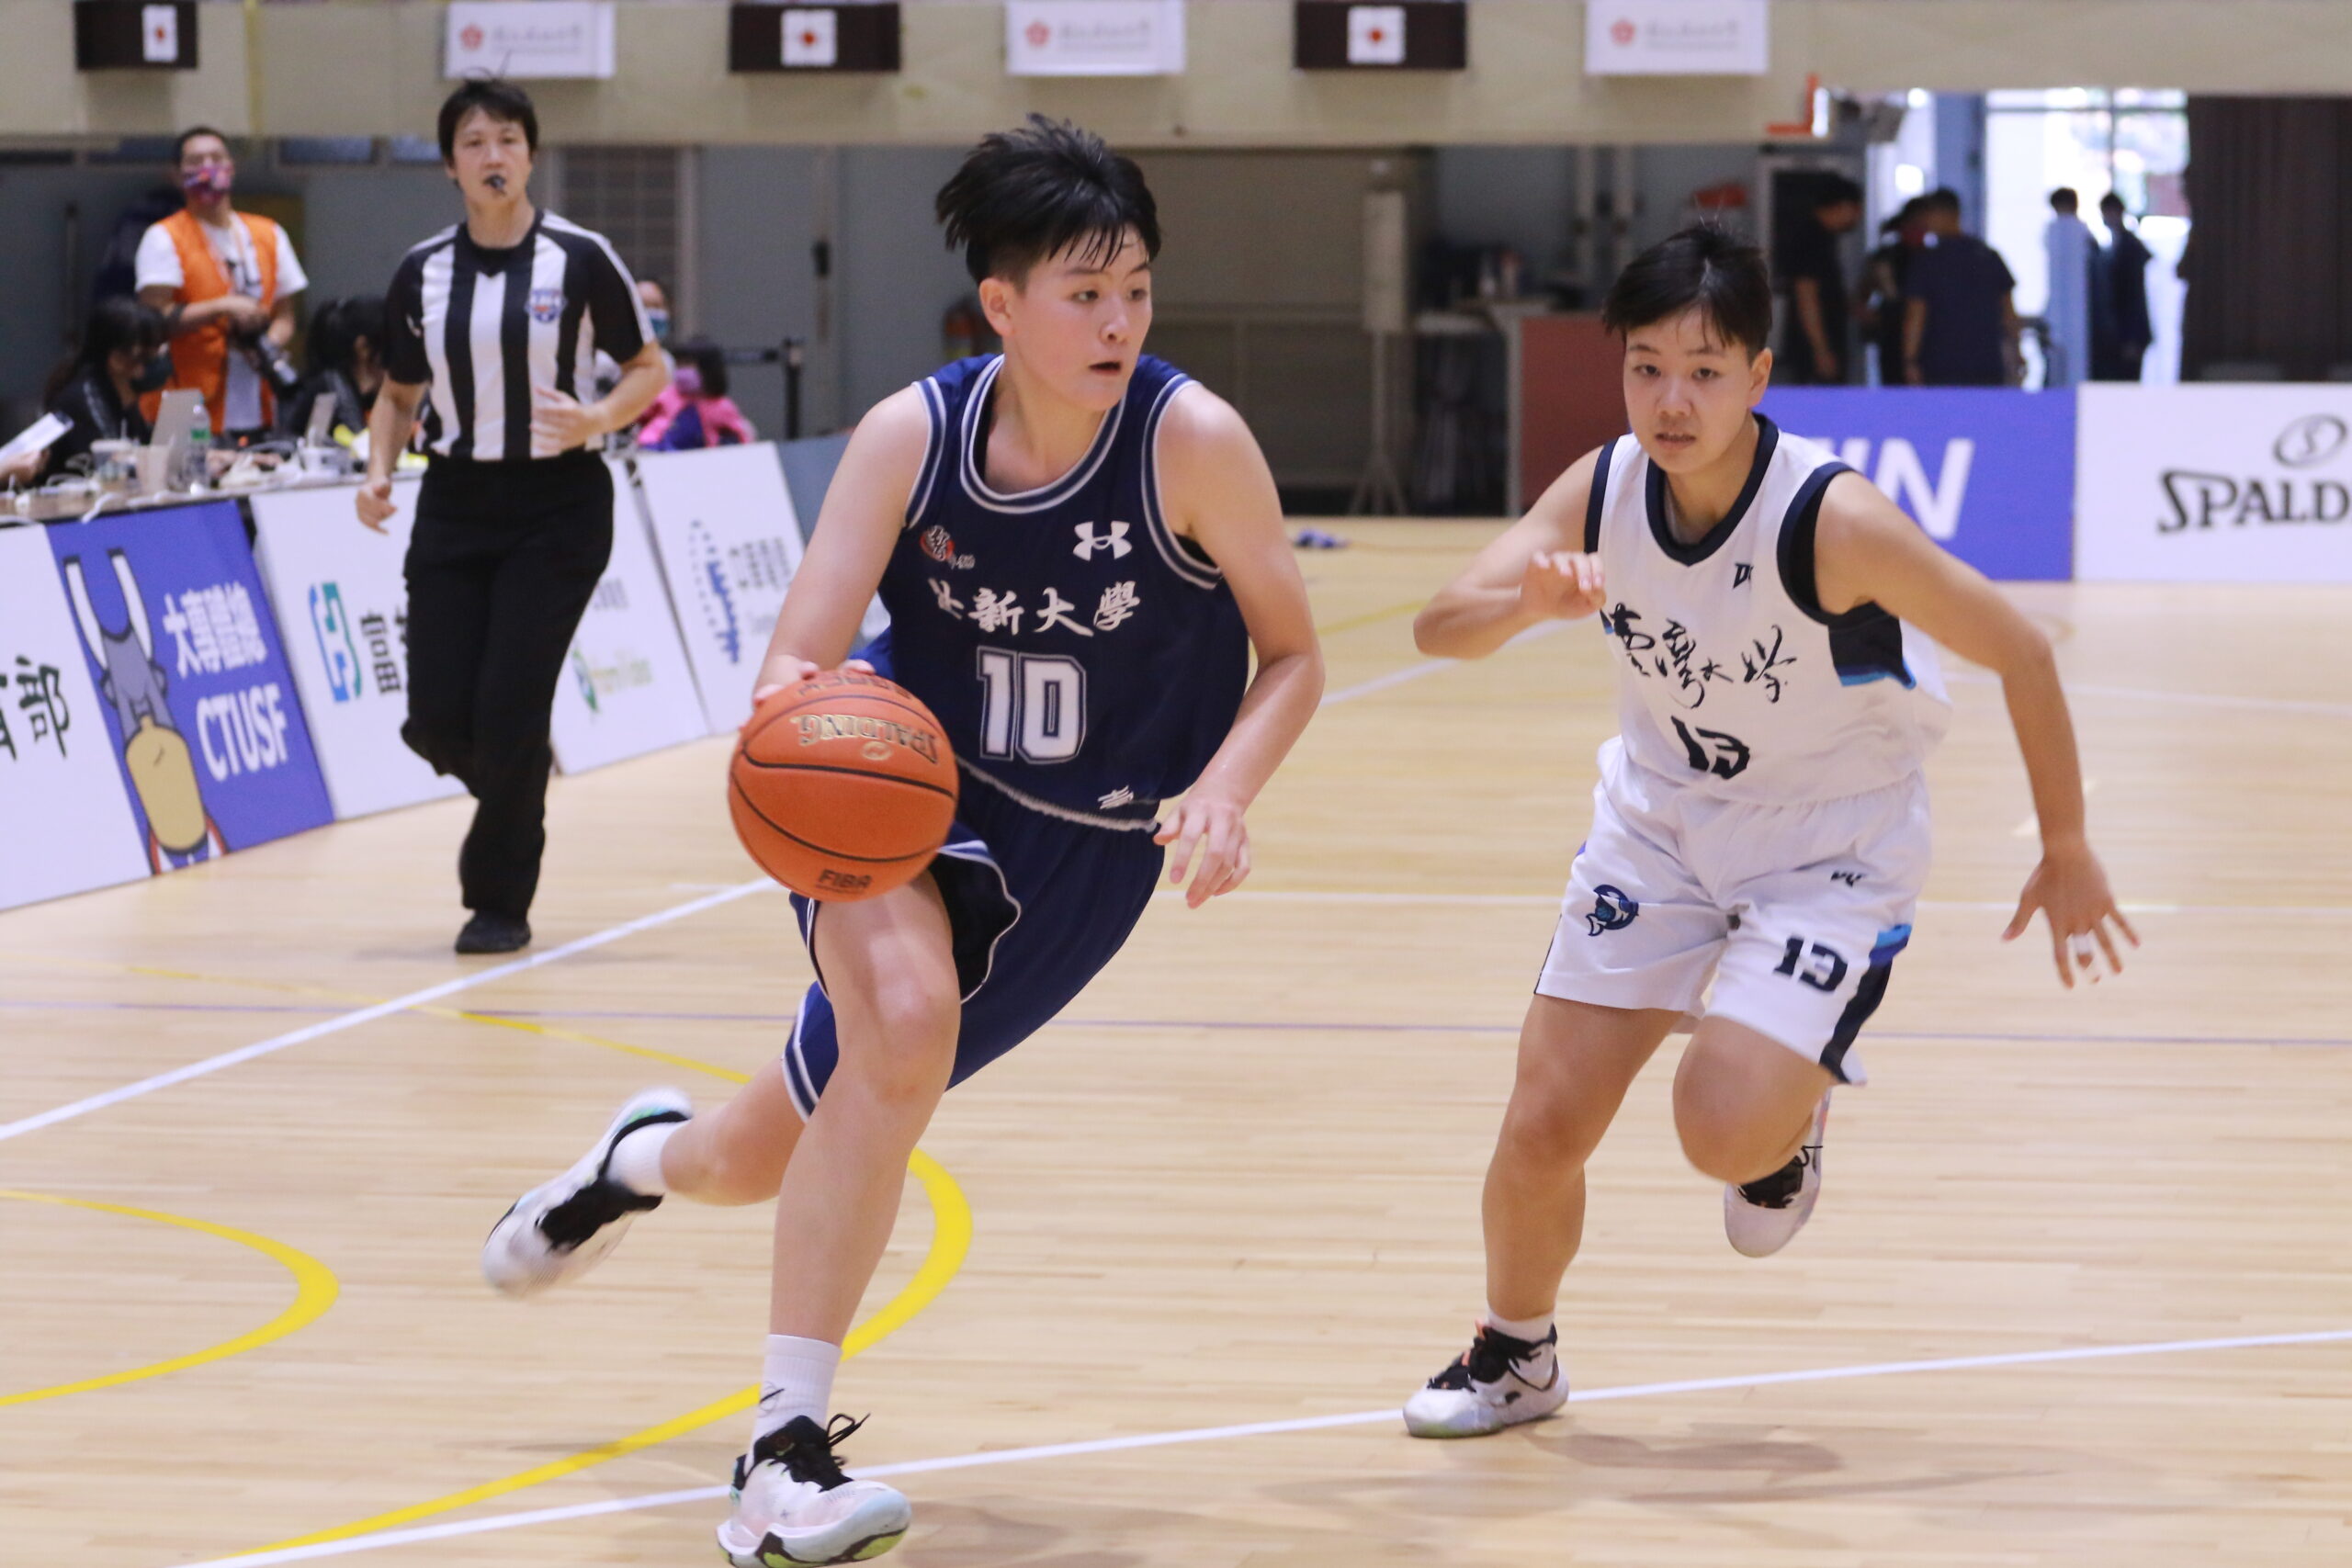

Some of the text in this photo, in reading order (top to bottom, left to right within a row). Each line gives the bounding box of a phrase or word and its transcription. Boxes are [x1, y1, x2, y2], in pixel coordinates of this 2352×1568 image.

[359, 607, 410, 695] 富
[196, 682, 290, 782] CTUSF
[791, 714, 938, 764] SPALDING
[977, 645, 1087, 765] 10
[818, 868, 873, 889] FIBA
[1772, 933, 1849, 993] 13
